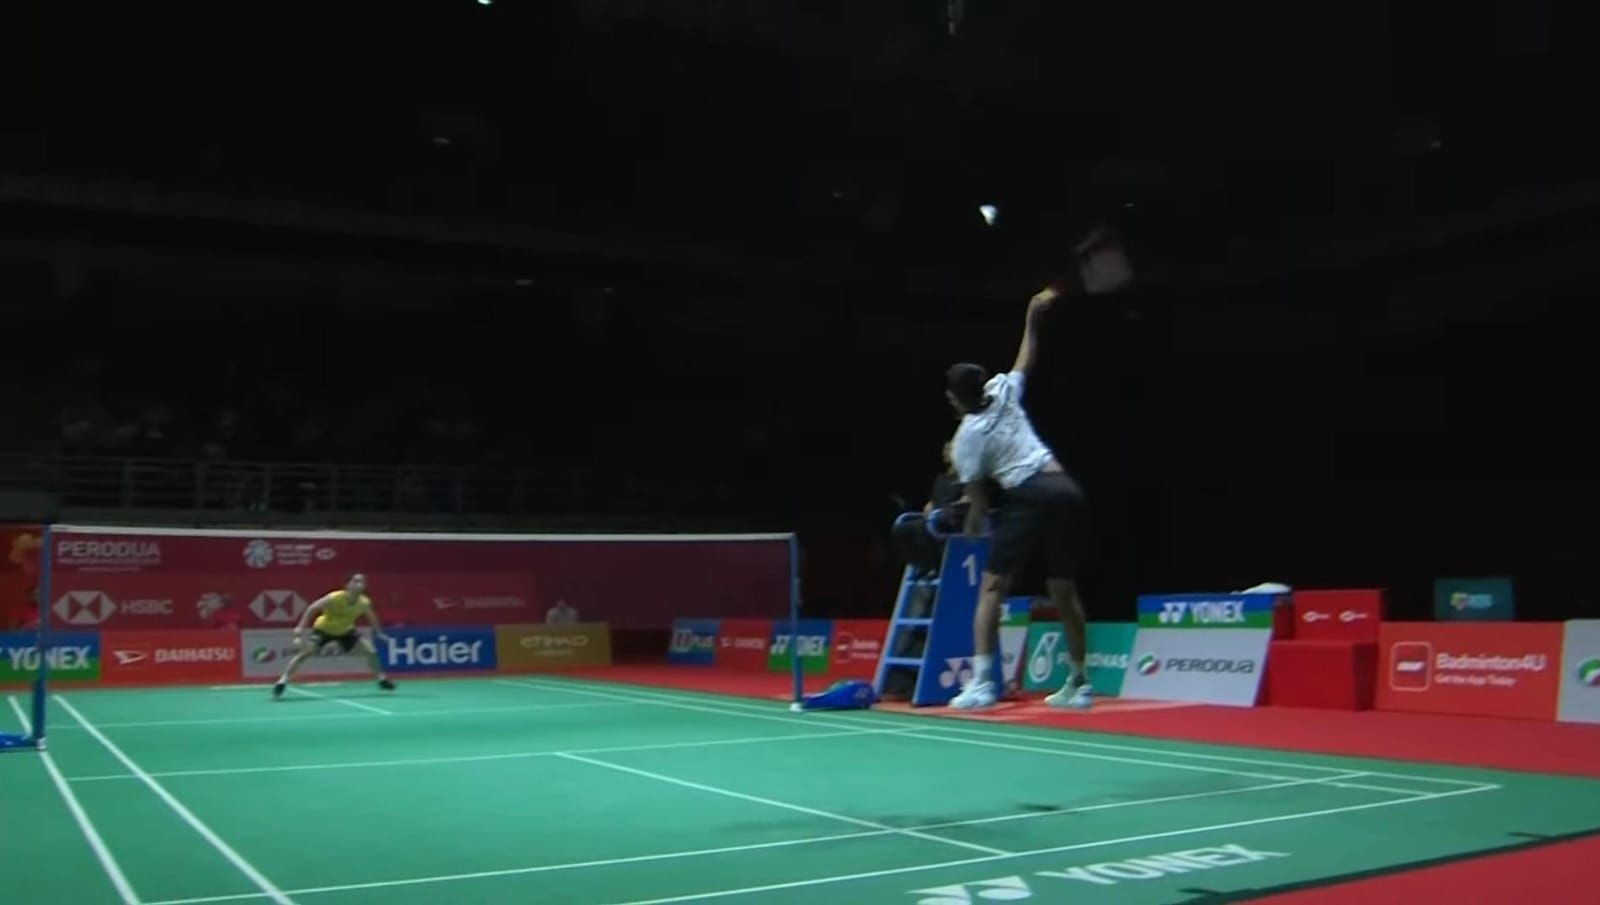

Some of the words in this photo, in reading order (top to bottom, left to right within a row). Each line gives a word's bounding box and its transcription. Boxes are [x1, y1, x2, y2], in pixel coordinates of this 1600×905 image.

[57, 541, 160, 557] PERODUA
[962, 554, 977, 586] 1
[121, 600, 173, 614] HSBC
[1190, 601, 1245, 622] YONEX
[155, 647, 235, 663] DAIHATSU
[388, 636, 483, 665] Haier
[1435, 653, 1547, 672] Badminton4U
[1034, 843, 1292, 885] YONEX
